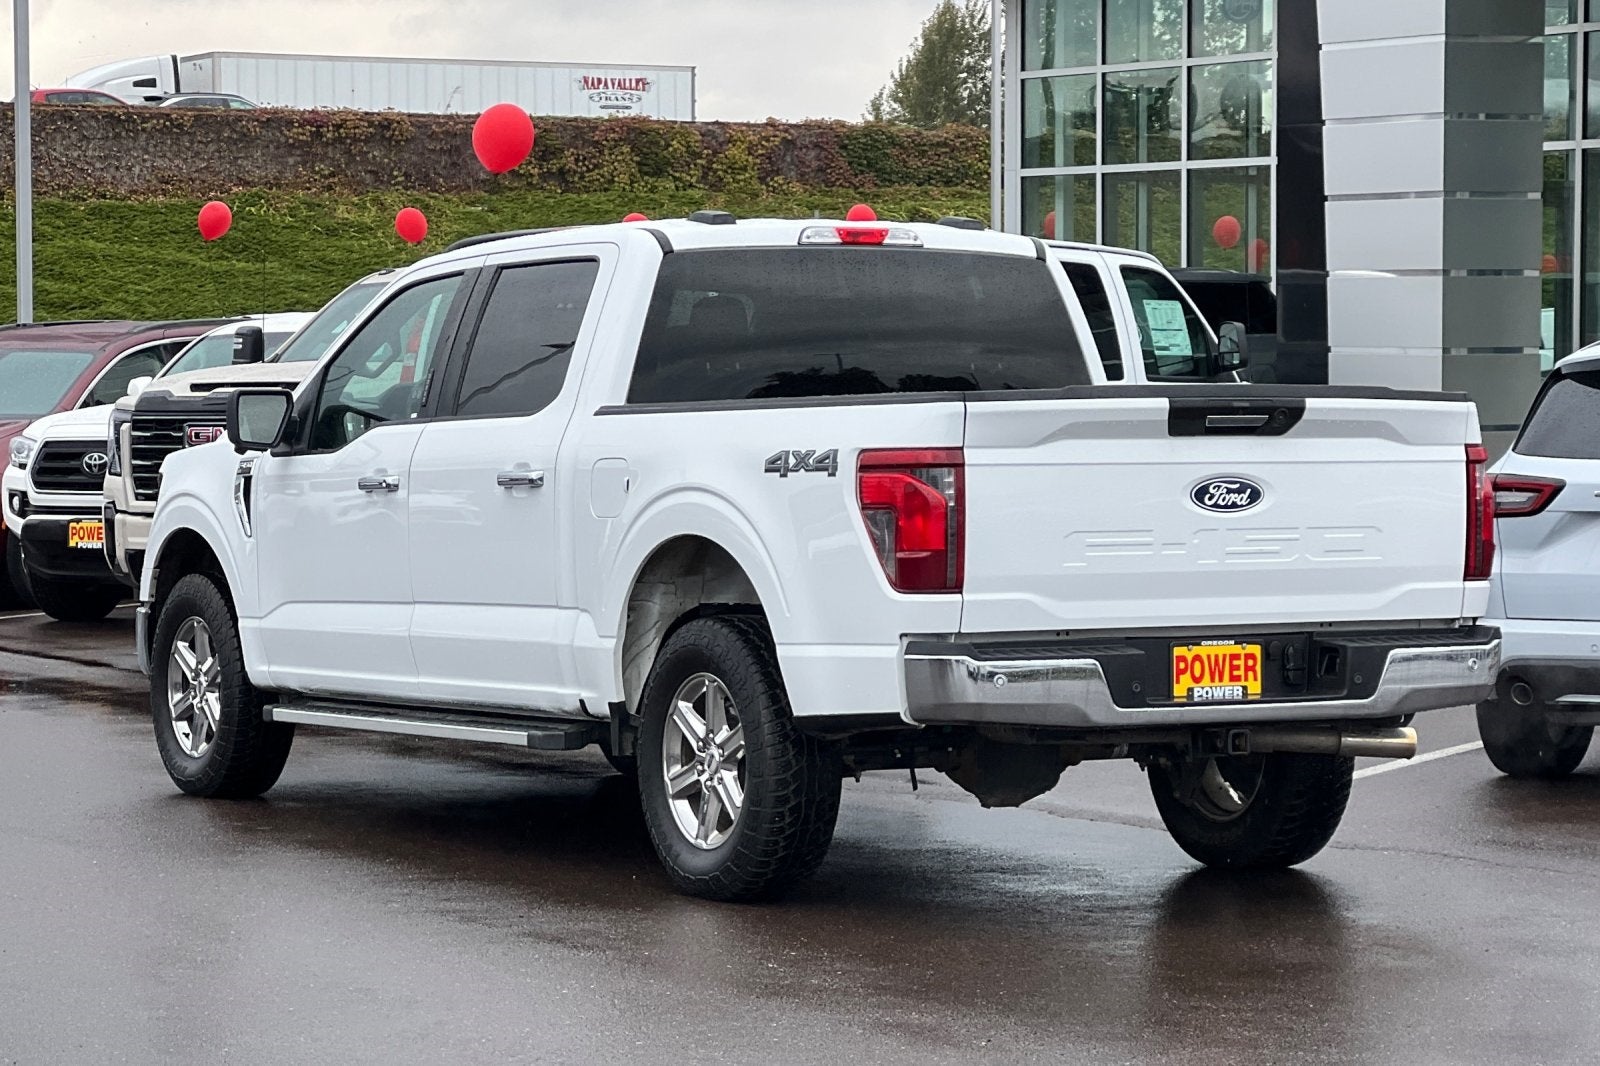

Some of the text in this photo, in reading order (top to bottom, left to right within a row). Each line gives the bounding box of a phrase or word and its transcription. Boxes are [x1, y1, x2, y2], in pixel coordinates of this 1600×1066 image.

[1204, 482, 1251, 506] Ford
[70, 526, 104, 541] POWE
[1175, 653, 1258, 685] POWER
[1193, 685, 1243, 700] POWER
